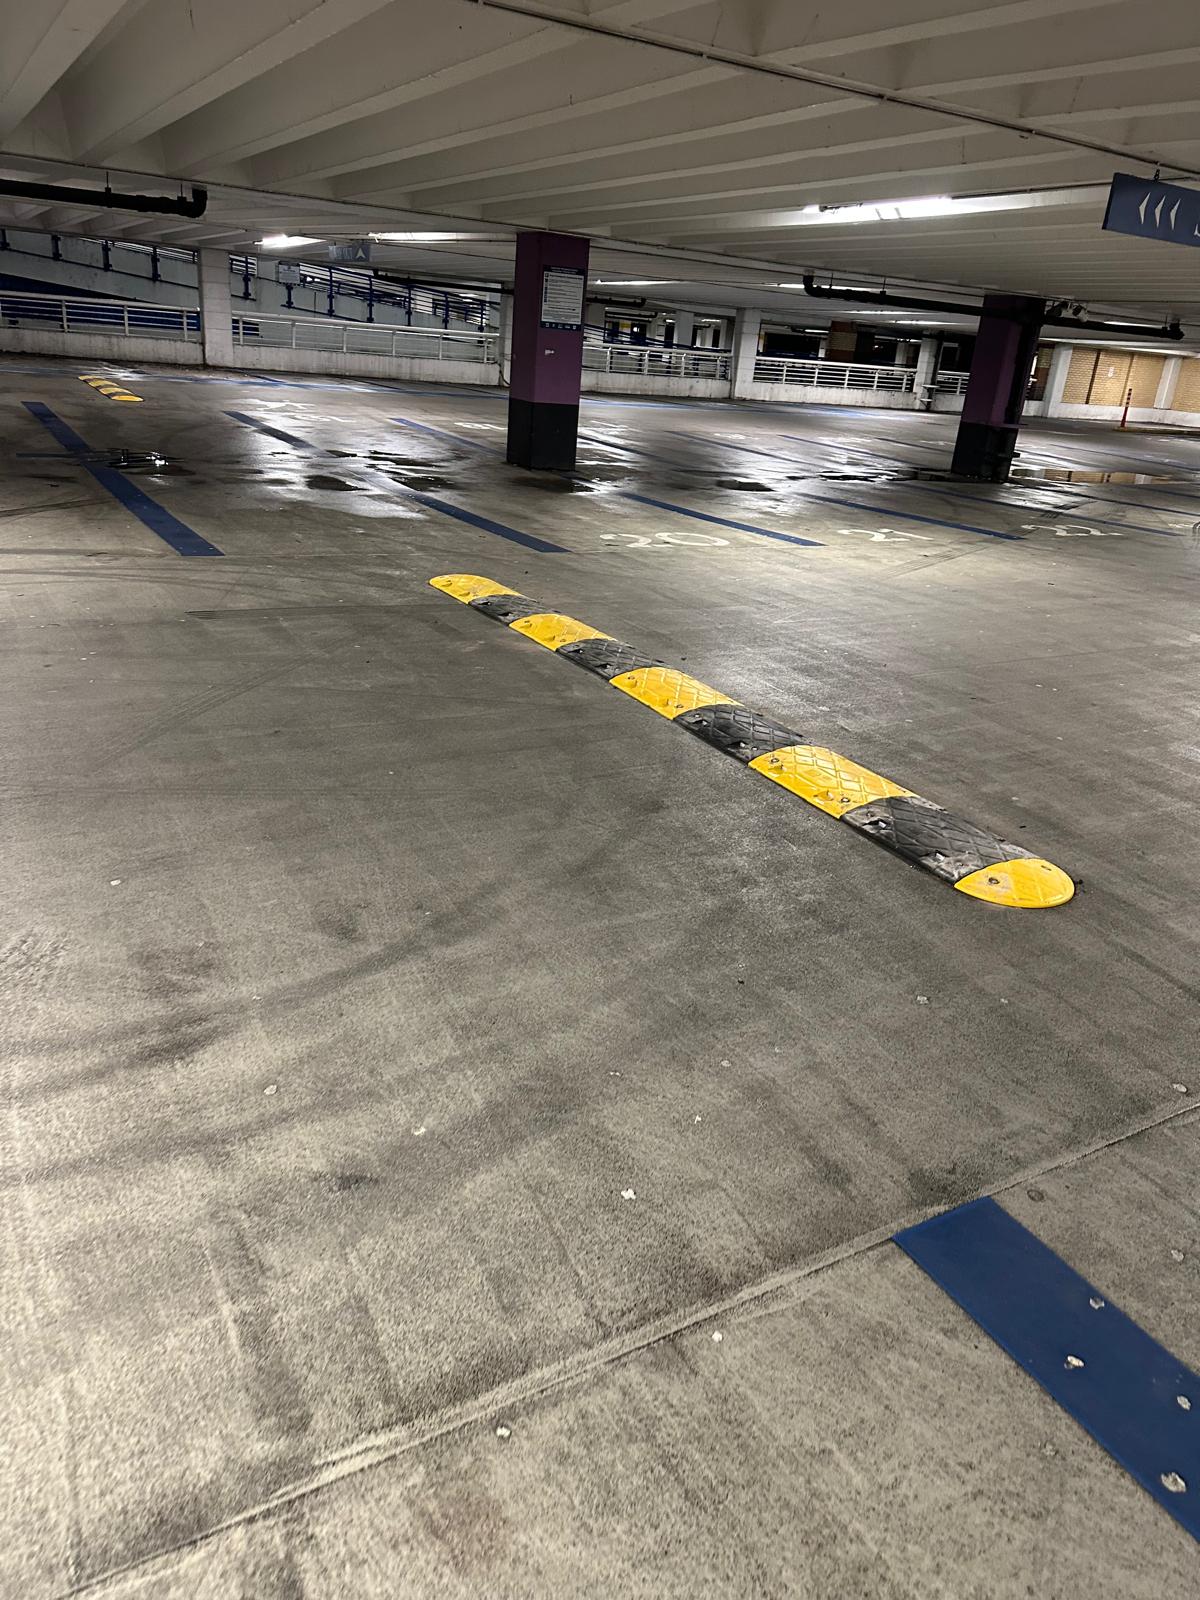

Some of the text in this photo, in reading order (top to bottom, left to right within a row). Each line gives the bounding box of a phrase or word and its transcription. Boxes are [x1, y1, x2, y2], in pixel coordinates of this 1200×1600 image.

[837, 528, 934, 542] 21
[1020, 524, 1123, 536] 22
[599, 532, 731, 548] 20
